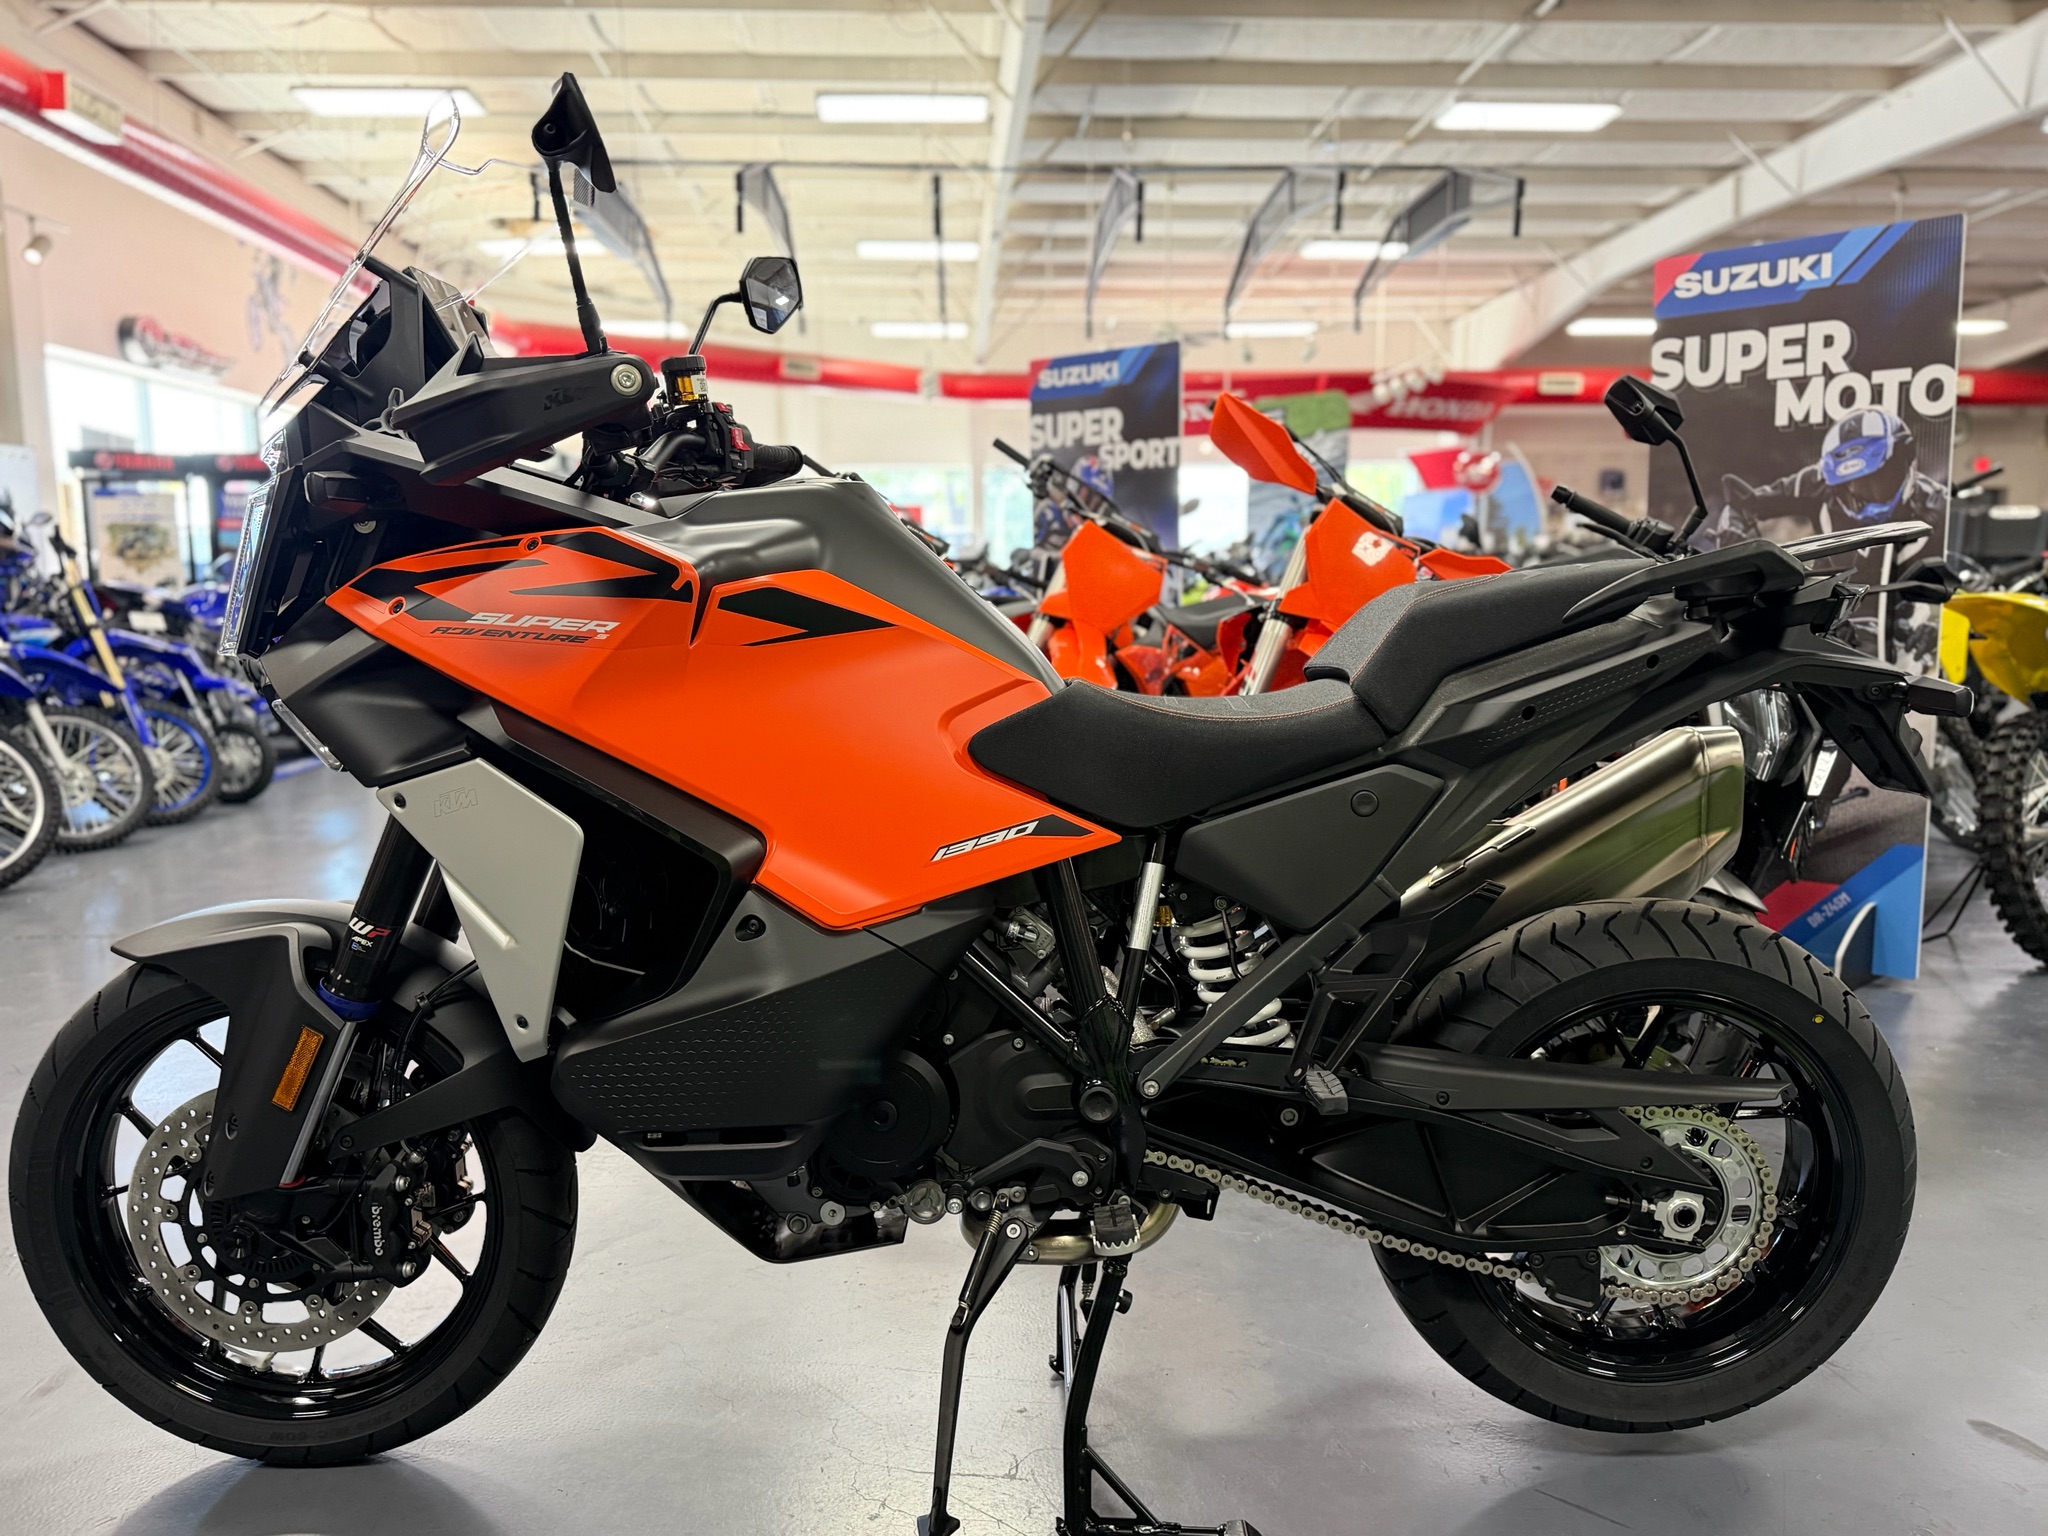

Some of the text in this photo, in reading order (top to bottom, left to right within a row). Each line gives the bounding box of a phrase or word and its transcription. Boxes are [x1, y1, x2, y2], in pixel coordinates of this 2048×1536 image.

[1674, 252, 1833, 299] SUZUKI
[1651, 319, 1852, 391] SUPER
[1038, 360, 1120, 389] SUZUKI
[1774, 363, 1957, 428] MOTO
[1031, 407, 1123, 450] SUPER
[1098, 436, 1180, 472] SPORT
[429, 626, 593, 644] ADVENTURE
[464, 612, 621, 633] SUPER
[433, 786, 479, 818] KTM
[930, 820, 1040, 862] 1390
[349, 916, 391, 938] WP
[351, 936, 373, 947] APEX
[371, 1206, 386, 1257] brembo
